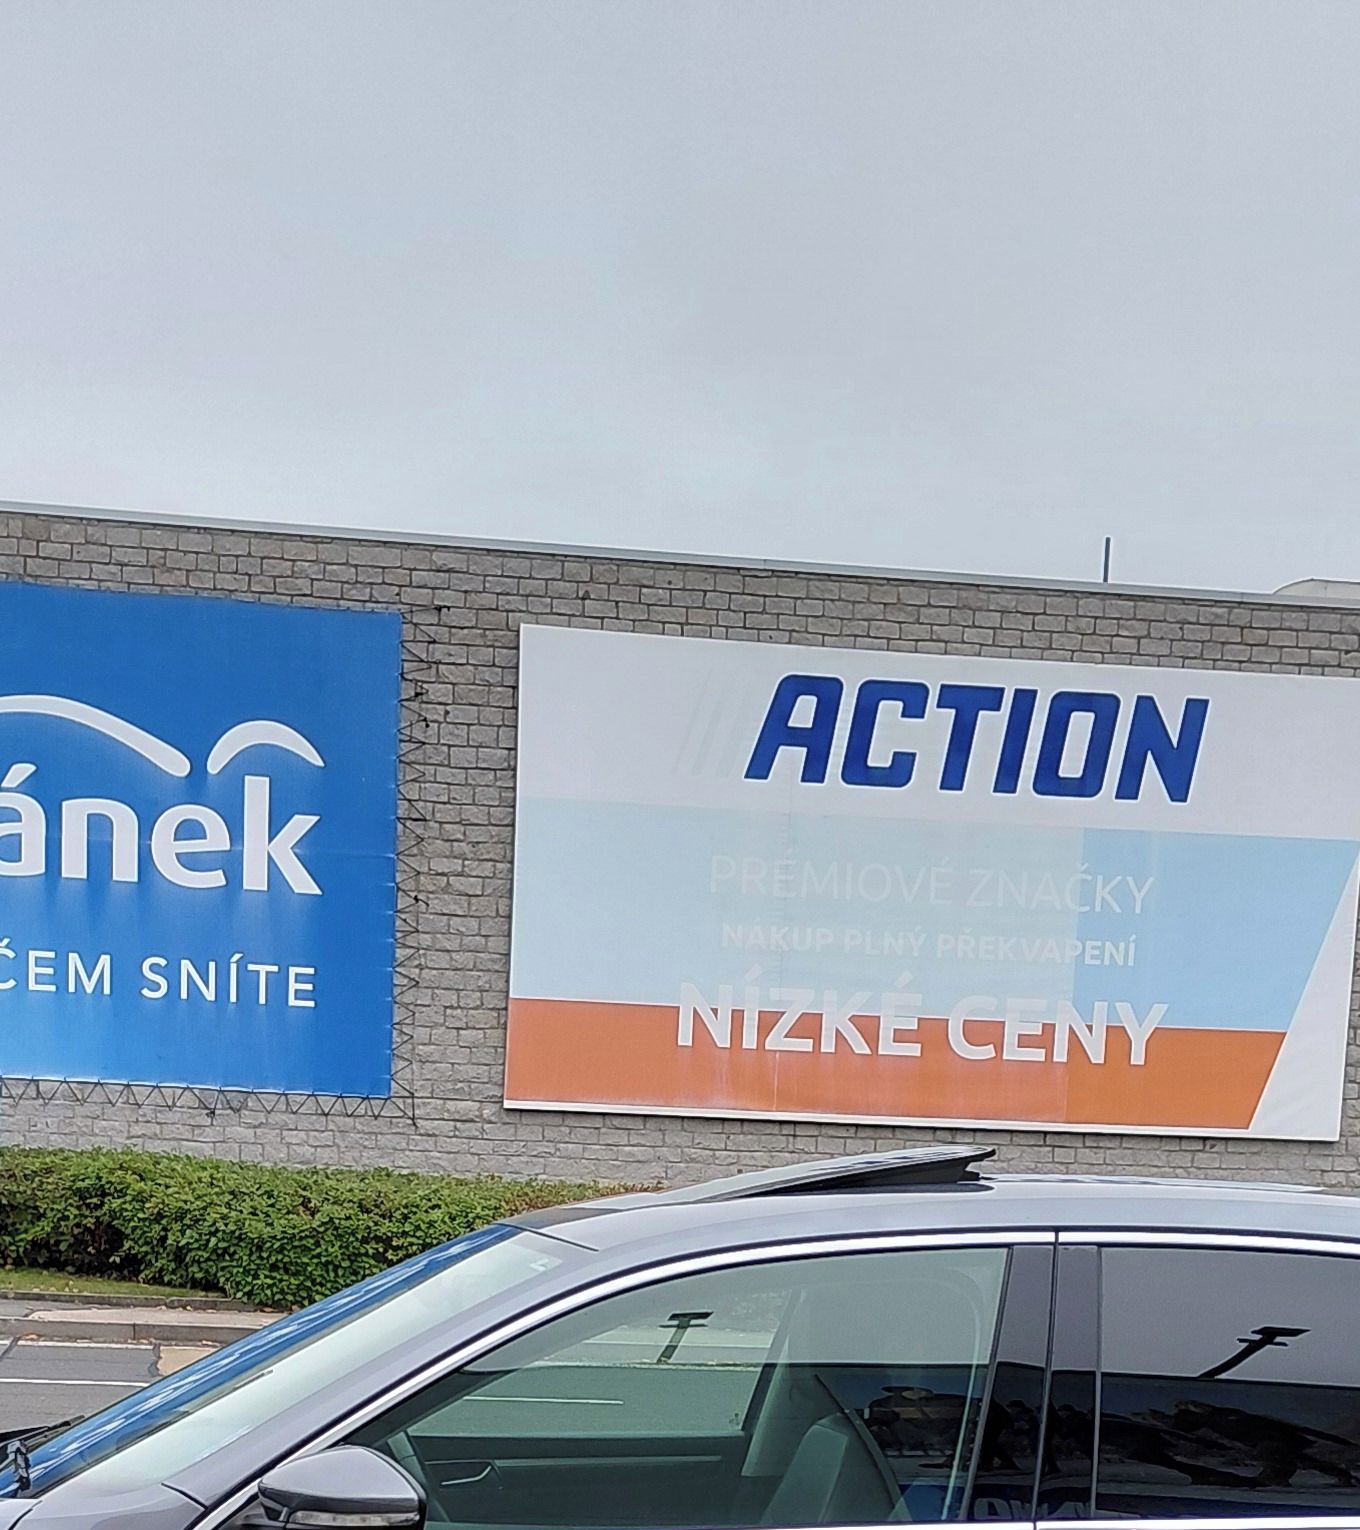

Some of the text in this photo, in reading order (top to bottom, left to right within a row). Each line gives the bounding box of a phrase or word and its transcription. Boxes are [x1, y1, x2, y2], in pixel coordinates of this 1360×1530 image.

[743, 672, 1211, 805] ACTION
[710, 850, 1155, 915] PRÉMIOVÉ ZNAČKY
[721, 918, 1137, 967] NÁKUP PLNÝ PŘEKVAPENÍ
[140, 952, 318, 1009] SNÍTE
[676, 963, 1169, 1067] NÍZKÉ CENY
